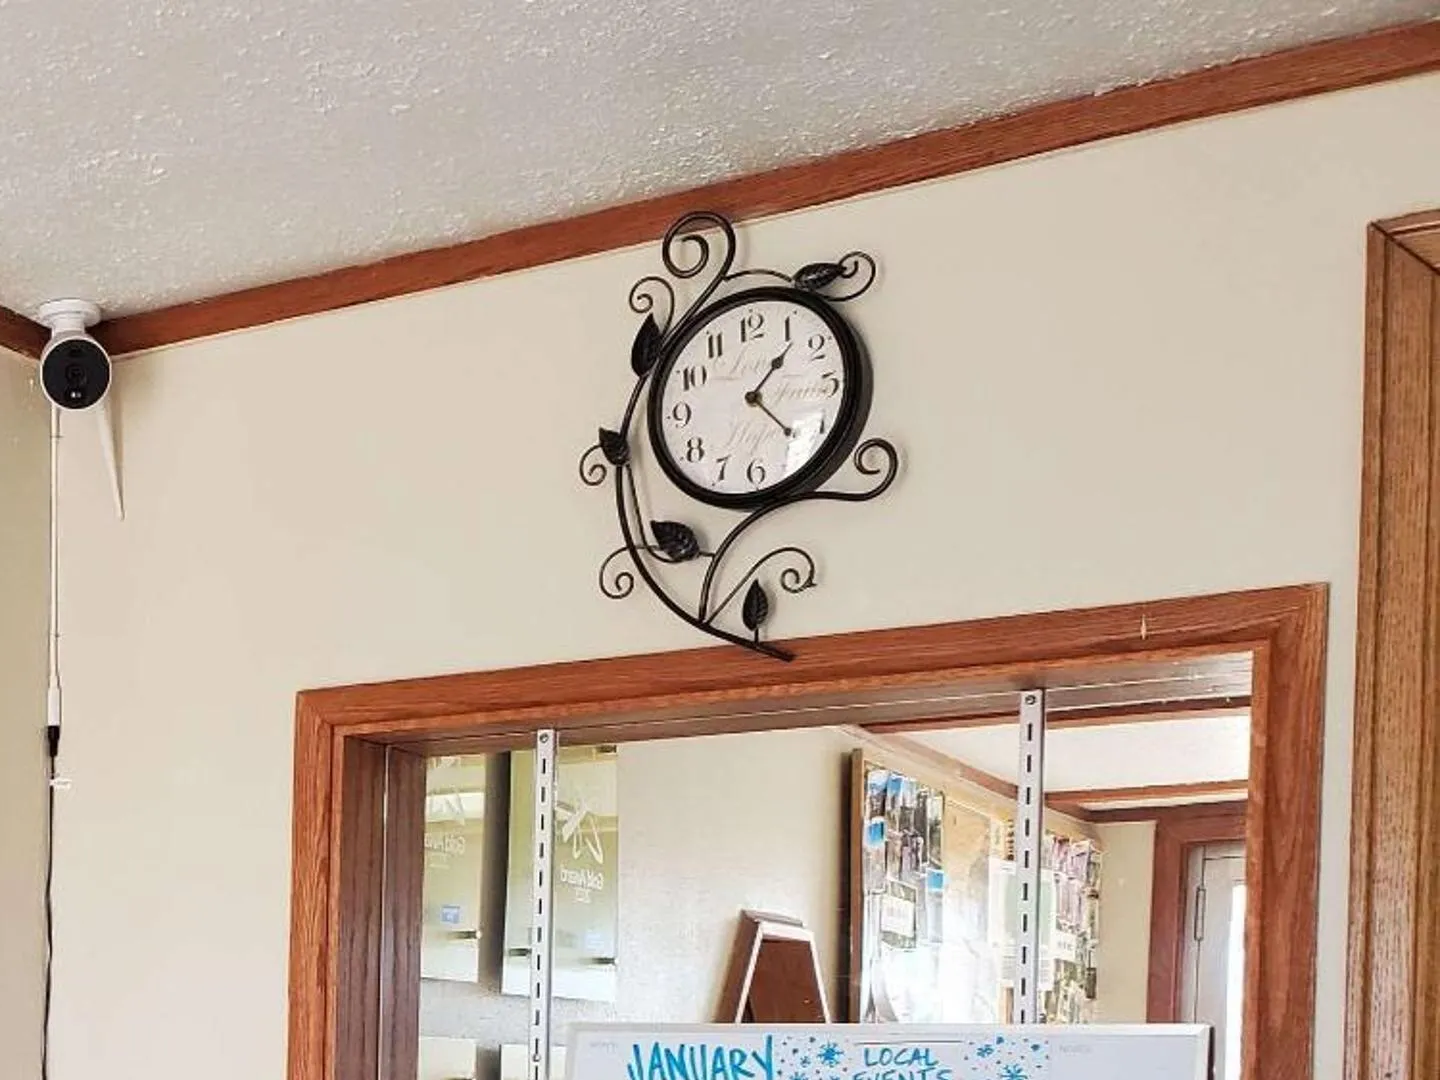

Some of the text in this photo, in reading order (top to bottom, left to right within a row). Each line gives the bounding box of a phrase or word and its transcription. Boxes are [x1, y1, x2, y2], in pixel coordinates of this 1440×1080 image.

[741, 313, 764, 343] 12
[784, 316, 791, 342] 1
[708, 332, 722, 359] 11
[808, 334, 826, 362] 2
[682, 365, 708, 391] 10
[821, 370, 840, 398] 3
[672, 401, 692, 428] 9
[686, 437, 704, 463] 8
[716, 454, 731, 481] 7
[746, 459, 766, 486] 6
[864, 1046, 939, 1067] LOCAL
